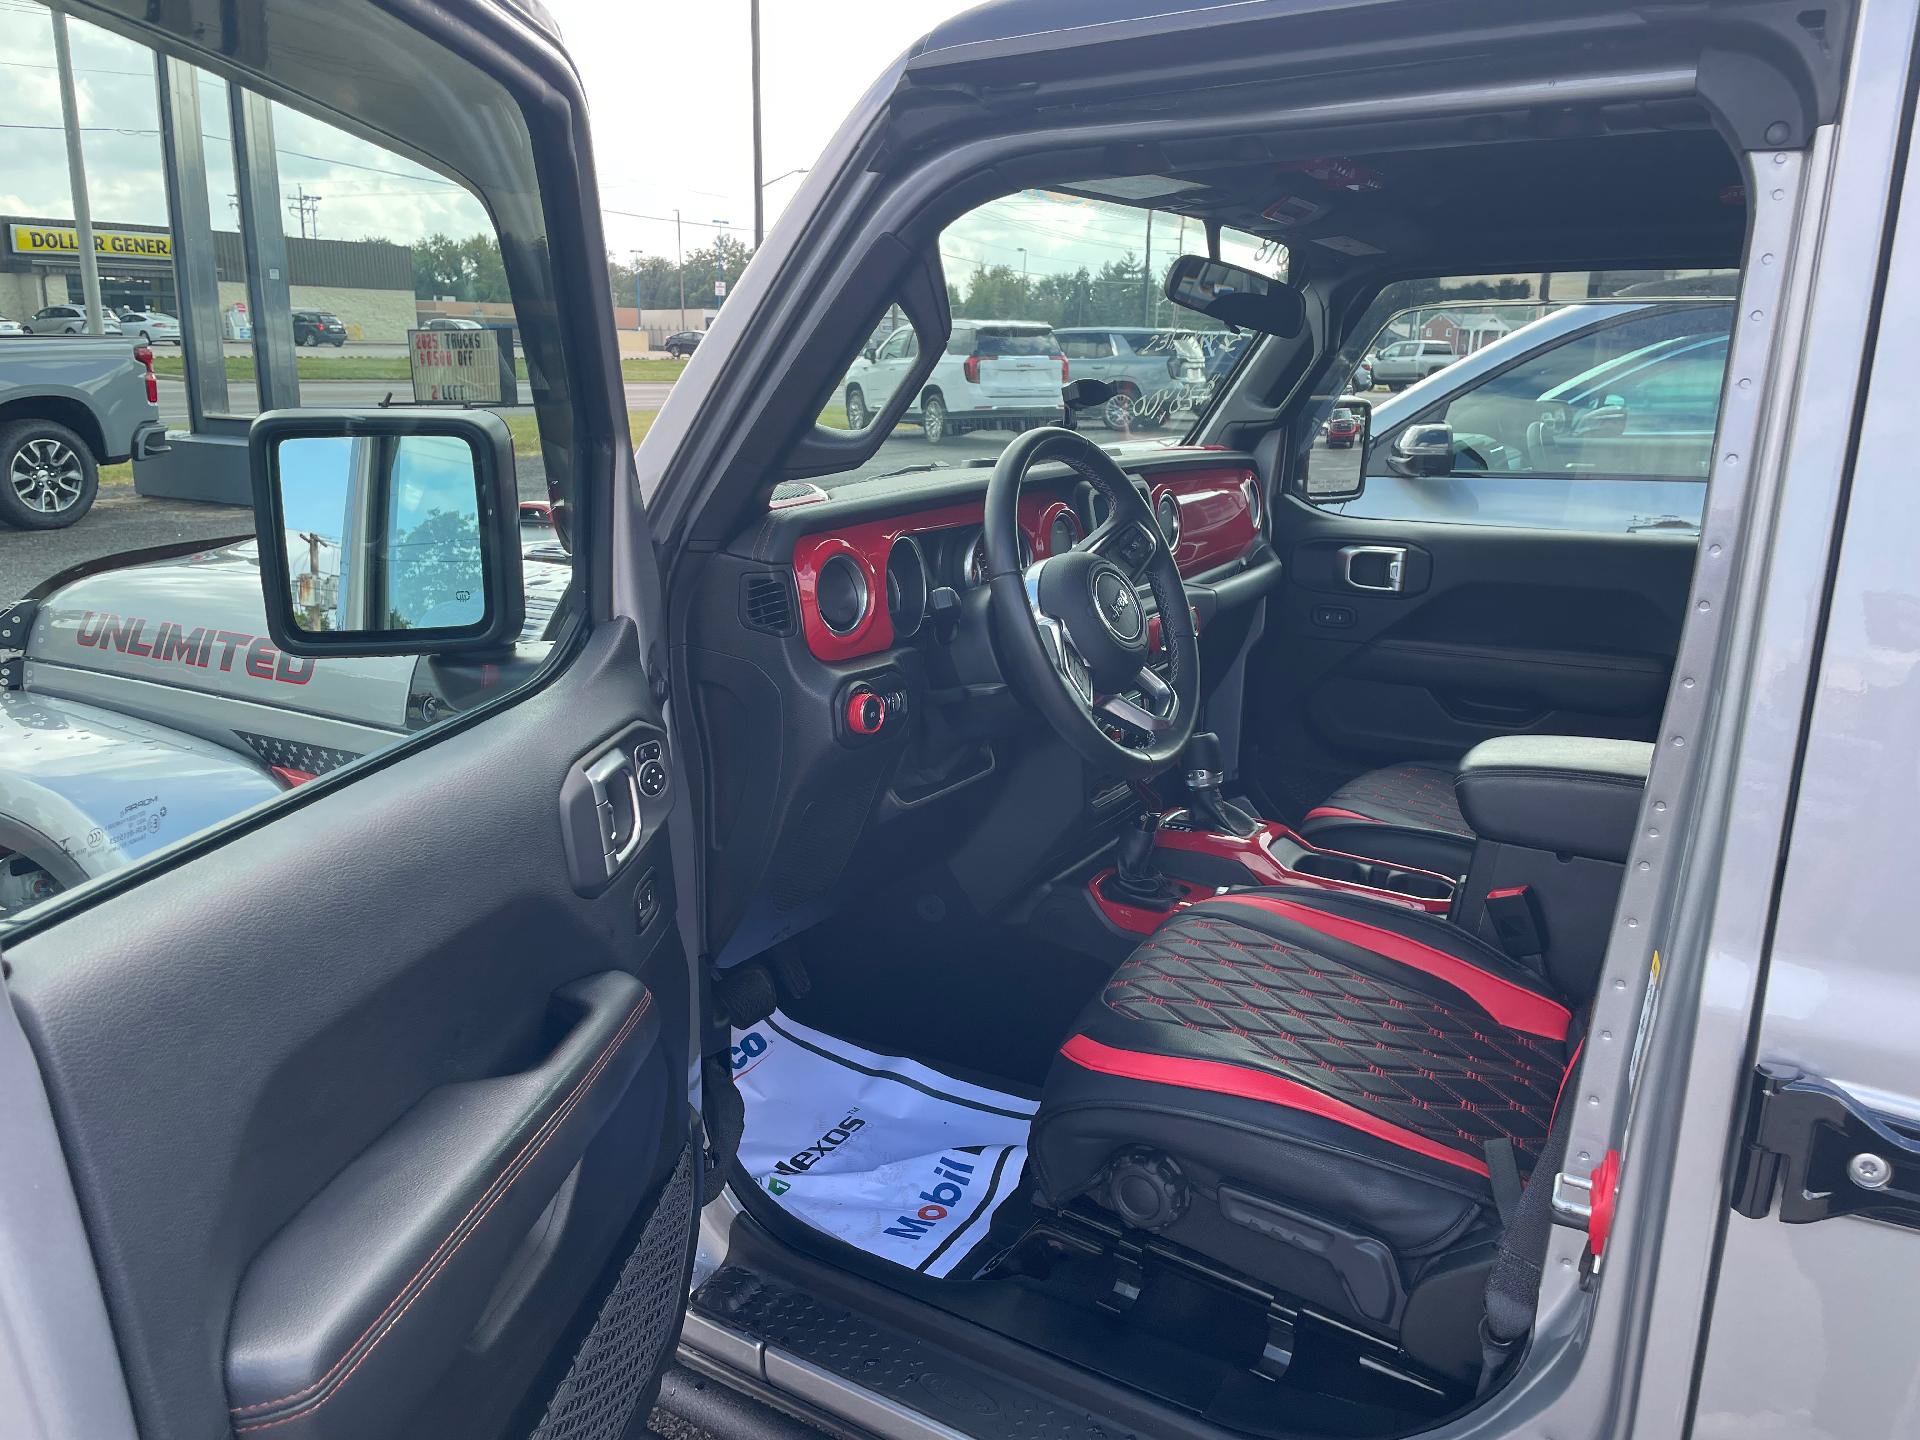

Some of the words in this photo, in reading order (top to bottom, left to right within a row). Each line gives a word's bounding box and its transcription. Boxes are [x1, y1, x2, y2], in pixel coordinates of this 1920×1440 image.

[30, 231, 104, 251] DOLLR
[111, 235, 171, 255] GENER
[416, 333, 438, 349] 2025
[445, 333, 480, 349] TRUCKS
[458, 351, 473, 366] OFF
[442, 385, 465, 400] LEFT
[883, 1156, 974, 1240] Mobil
